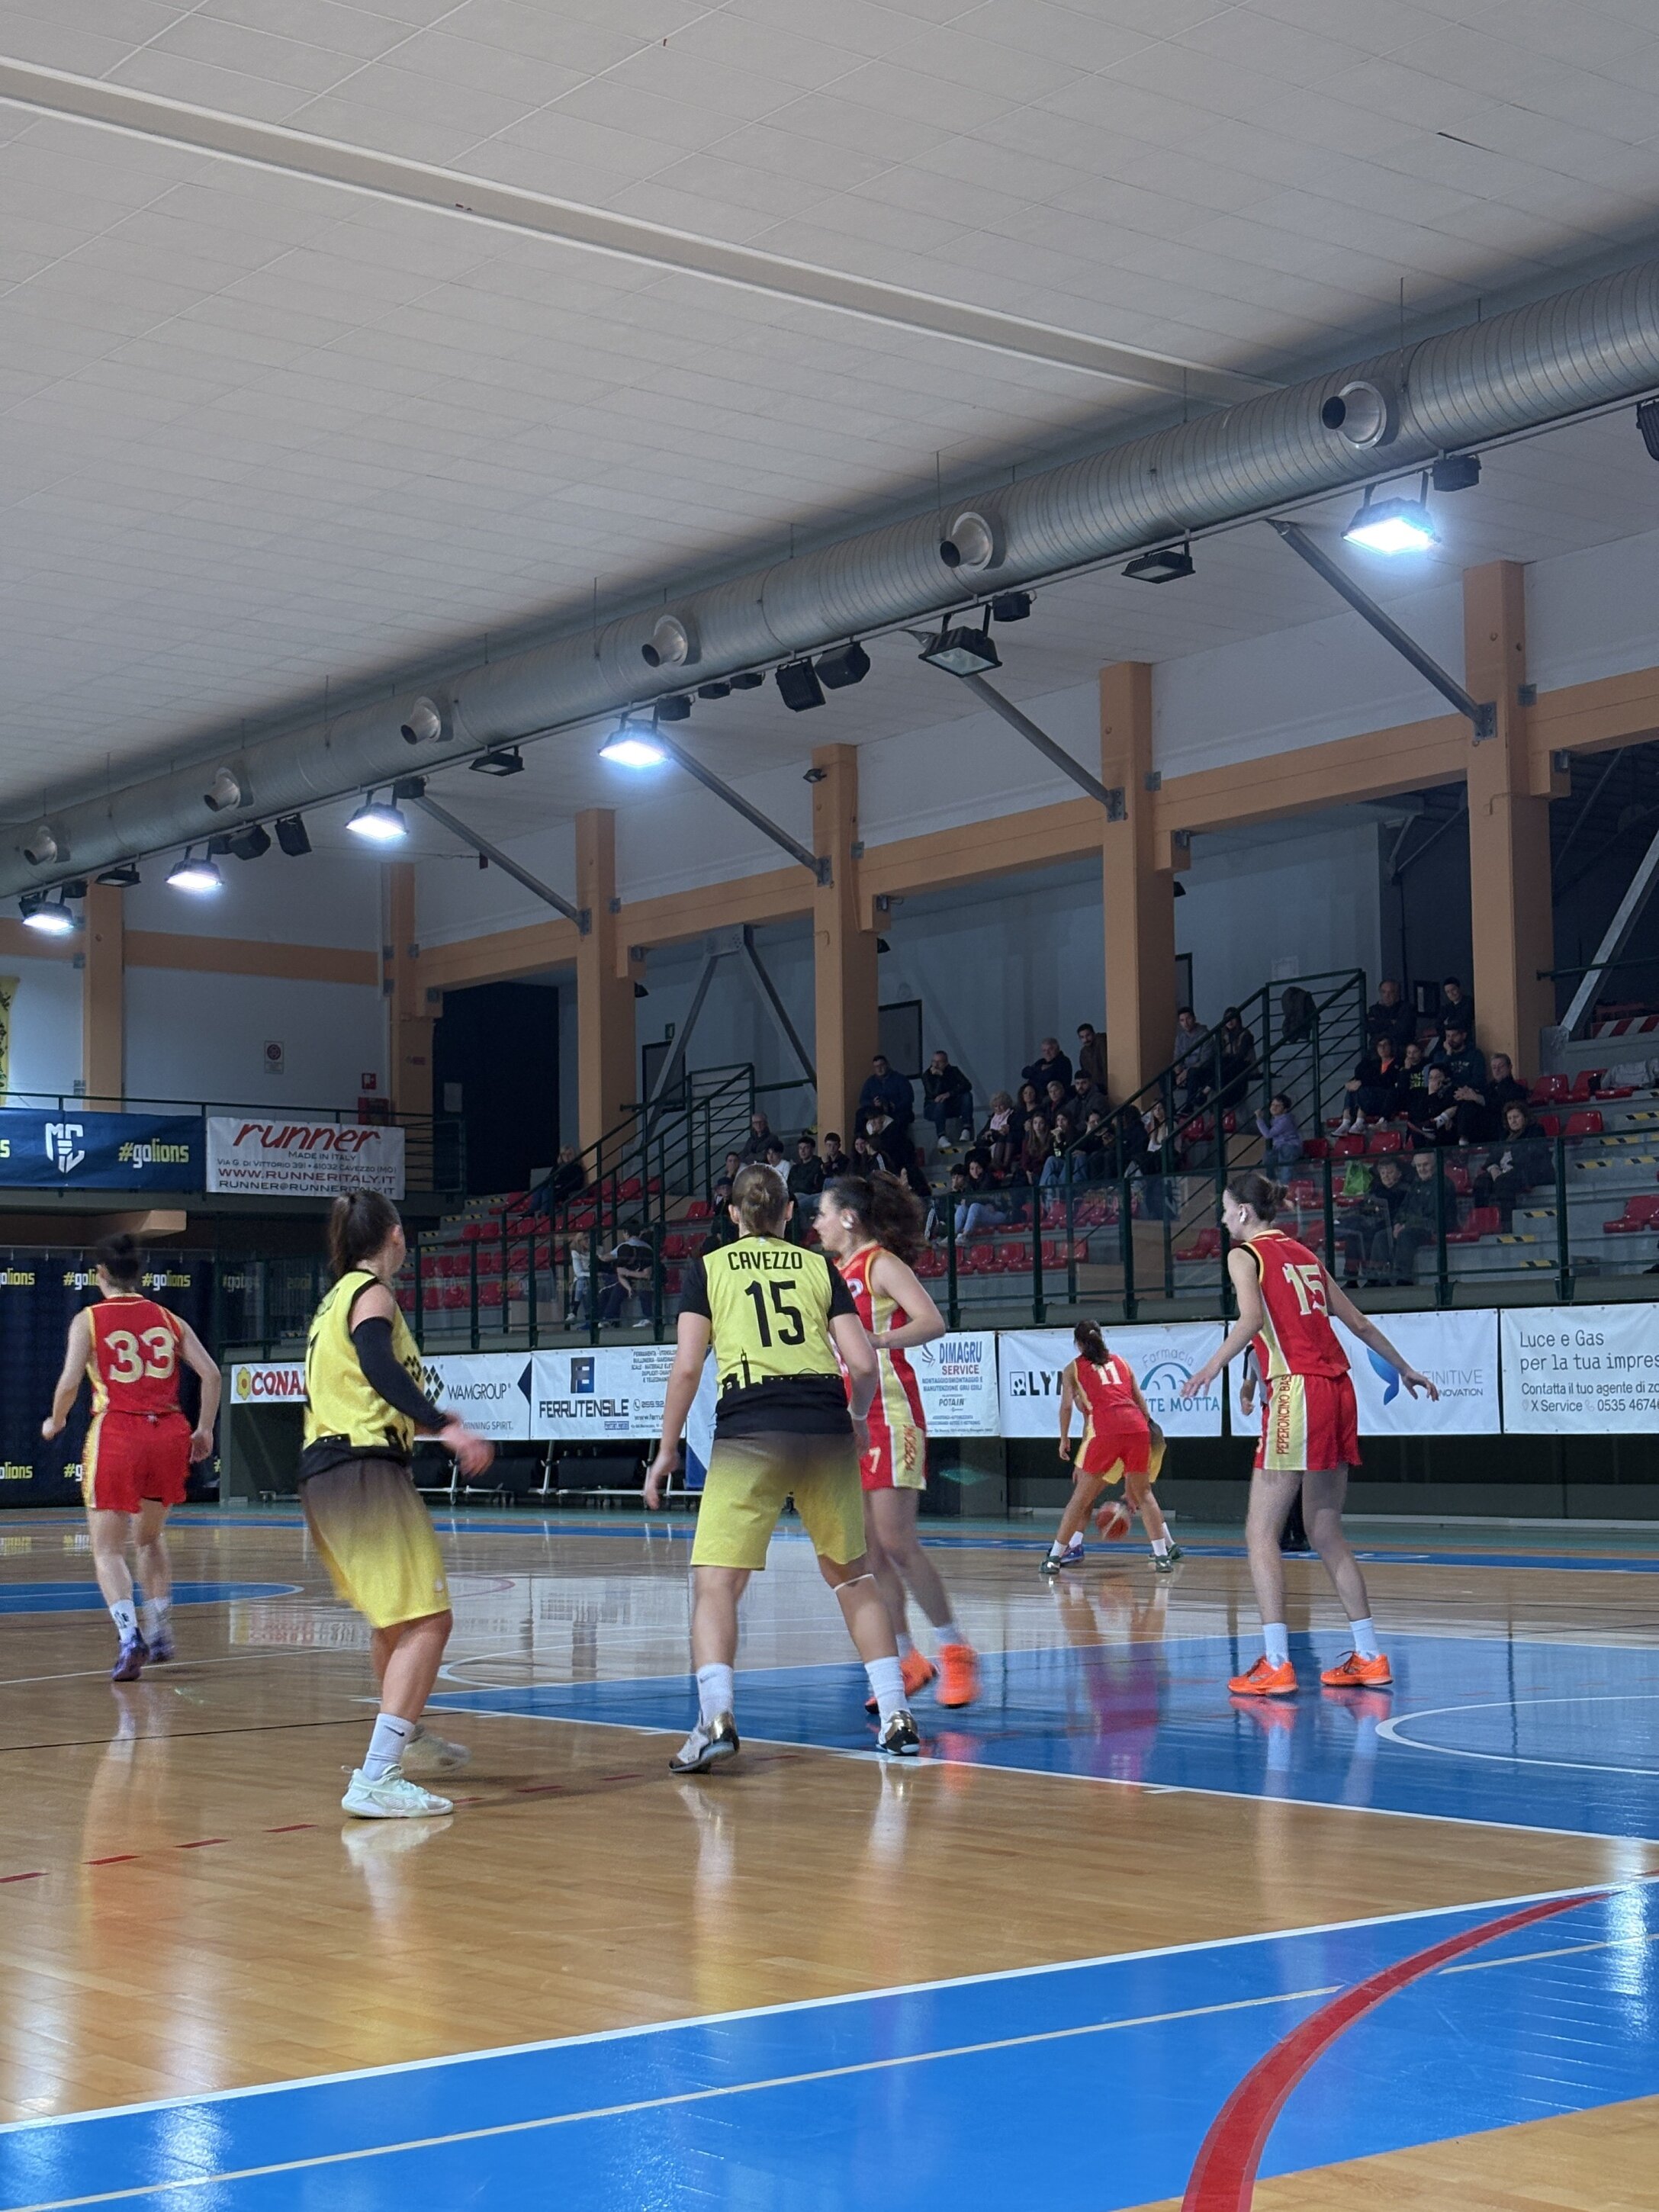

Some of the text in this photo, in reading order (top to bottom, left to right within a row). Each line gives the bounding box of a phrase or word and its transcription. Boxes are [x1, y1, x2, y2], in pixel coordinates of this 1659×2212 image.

[233, 1124, 381, 1153] runner
[118, 1138, 189, 1169] #golions
[218, 1168, 396, 1185] WWW.RUNNERITALY.IT
[727, 1251, 803, 1272] CAVEZZO
[141, 1270, 191, 1291] #golions
[1282, 1262, 1327, 1317] 15
[744, 1279, 805, 1348] 15
[1520, 1329, 1604, 1348] Luce e Gas
[104, 1326, 175, 1383] 33
[939, 1341, 982, 1364] DIMAGRU
[1142, 1349, 1194, 1368] Farmacia
[942, 1365, 979, 1375] SERVICE
[1091, 1361, 1123, 1385] 11
[1520, 1357, 1547, 1374] per
[1551, 1354, 1568, 1371] la
[1573, 1353, 1601, 1370] tua
[251, 1371, 307, 1396] CONA
[1522, 1382, 1566, 1395] Contatta
[1568, 1382, 1574, 1394] il
[1576, 1383, 1593, 1394] tuo
[1596, 1381, 1632, 1397] agente
[1635, 1381, 1645, 1394] di
[539, 1398, 629, 1418] FERRUTENSILE
[1171, 1397, 1220, 1412] MOTTA
[1531, 1400, 1539, 1412] X
[1541, 1400, 1583, 1412] Service
[1597, 1398, 1625, 1411] 0535
[1277, 1394, 1290, 1455] PEPERONCINO
